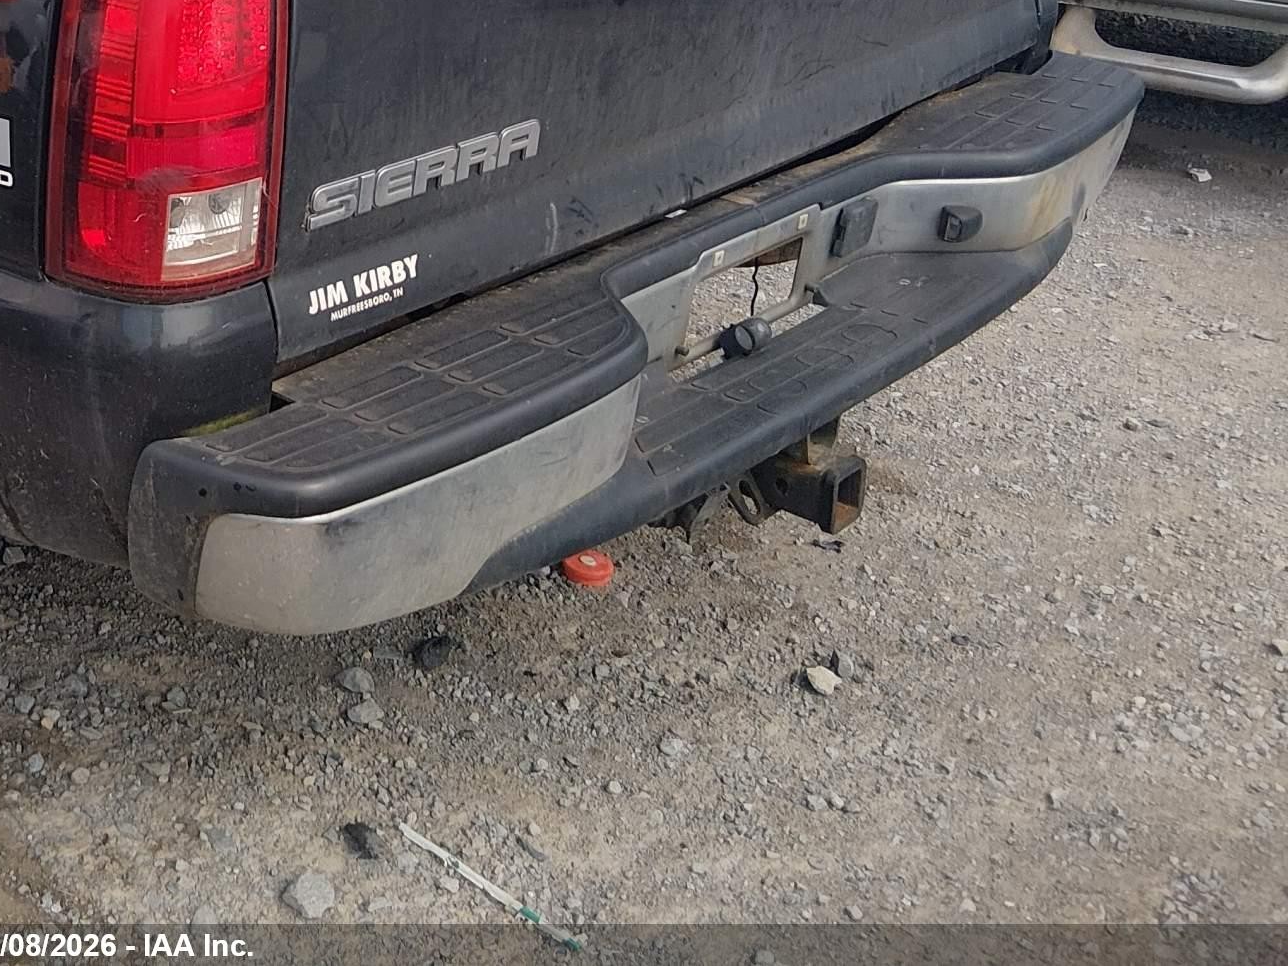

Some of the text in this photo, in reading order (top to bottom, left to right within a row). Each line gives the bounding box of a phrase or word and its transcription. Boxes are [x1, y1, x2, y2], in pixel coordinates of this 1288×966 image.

[304, 118, 541, 232] SIERRA
[309, 254, 418, 315] JIM KIRBY
[331, 287, 404, 322] MURFREESBORO, TN
